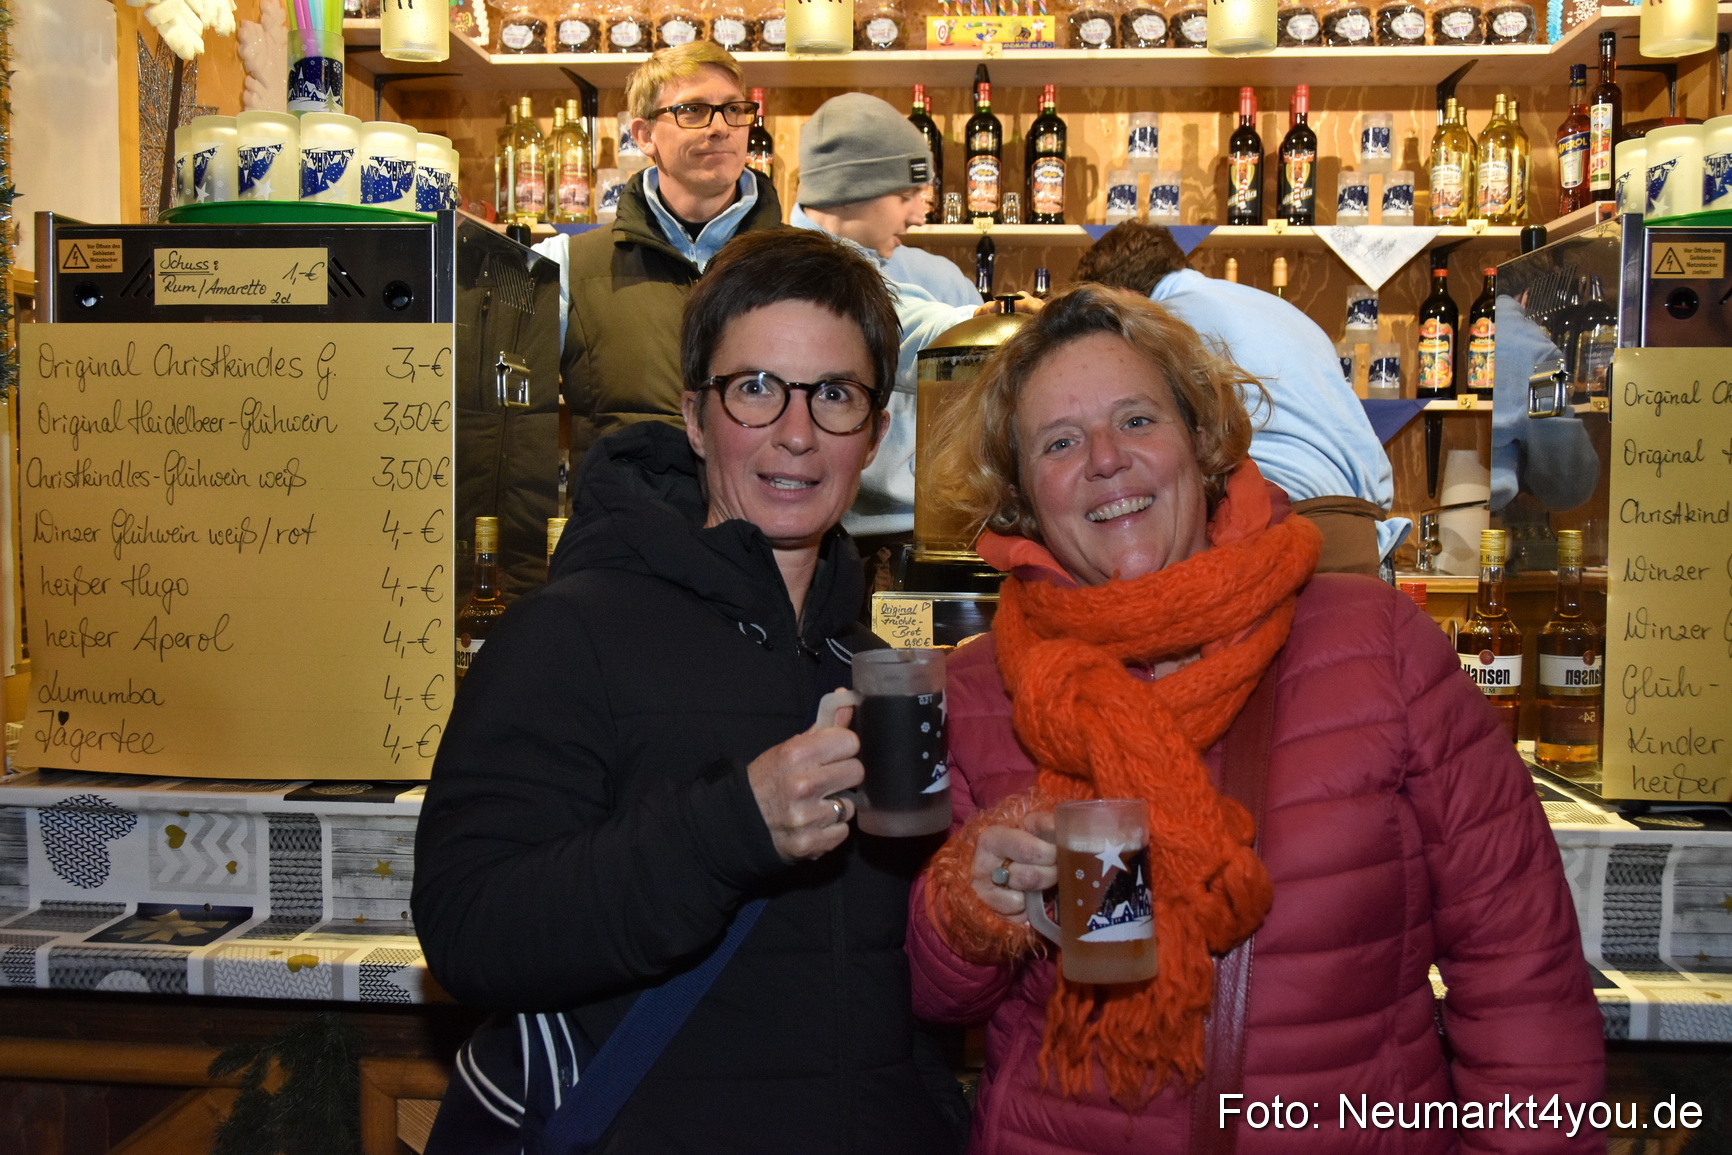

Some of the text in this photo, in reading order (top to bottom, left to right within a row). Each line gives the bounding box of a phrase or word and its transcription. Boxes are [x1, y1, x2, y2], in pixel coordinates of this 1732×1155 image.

[1558, 136, 1588, 154] APEROL
[38, 342, 452, 400] Original Christkindes G. 3,-€
[1624, 380, 1732, 417] Original Ch
[38, 397, 452, 451] Original Heidelbeer-Glühwein 3,50€
[1624, 438, 1704, 478] Original
[26, 450, 452, 505] Christkindles-Glühwein weiß 3,50€
[34, 508, 102, 545] Winzer
[111, 508, 201, 561] Glühwein
[1624, 555, 1710, 583] Winzer
[41, 565, 112, 604] heißer
[121, 563, 189, 614] Hugo
[880, 602, 918, 617] Original
[1624, 606, 1712, 642] Winzer
[44, 616, 119, 658] heißer
[134, 613, 234, 663] Aperol
[892, 625, 922, 638] Brot
[38, 670, 165, 706] Lumumba
[1464, 664, 1510, 684] Hansen
[1480, 686, 1496, 694] UM
[1622, 664, 1720, 715] Glüh-
[36, 710, 165, 764] Jägertee
[1627, 726, 1725, 756] Kinder
[1632, 763, 1726, 800] heißer
